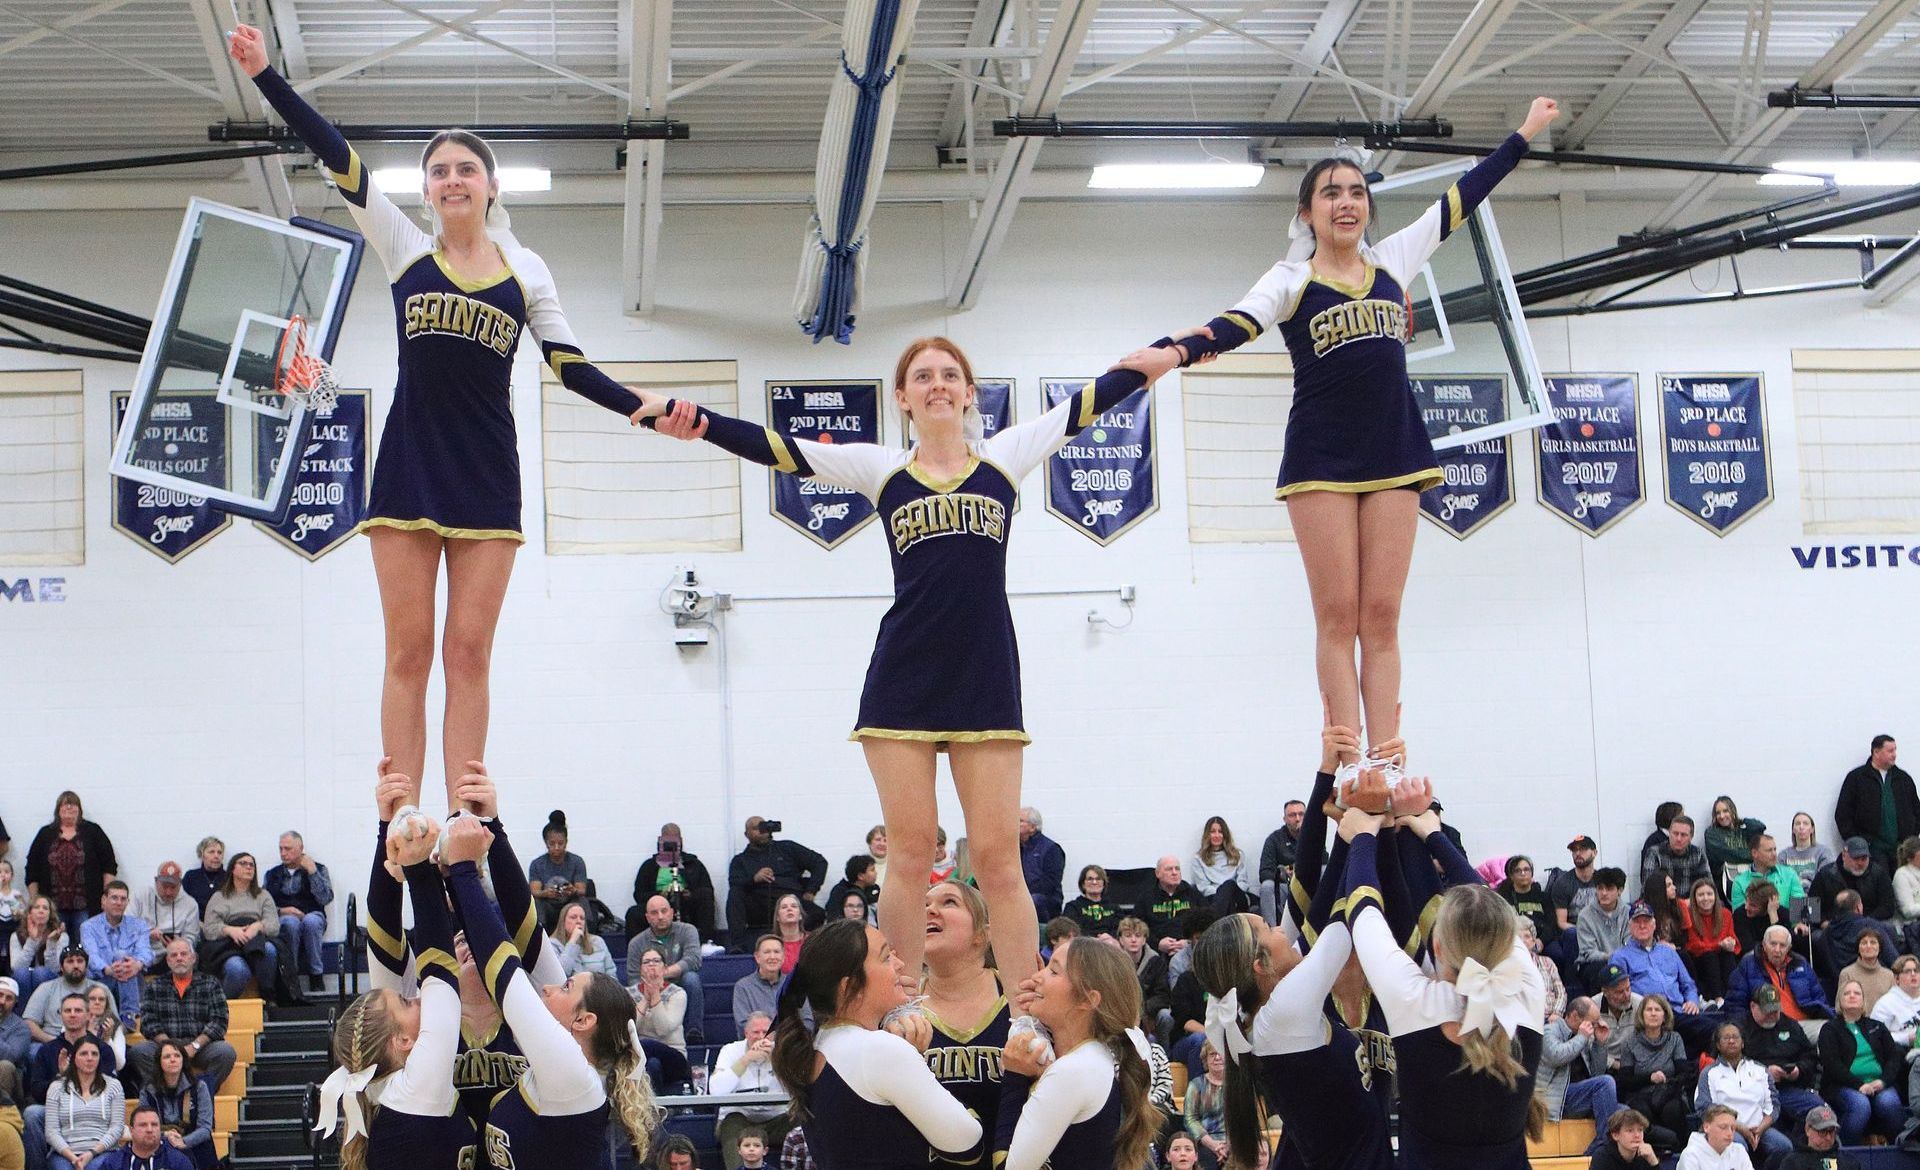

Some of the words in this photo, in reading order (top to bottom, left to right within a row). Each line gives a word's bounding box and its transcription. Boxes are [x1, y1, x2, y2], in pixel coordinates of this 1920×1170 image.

[405, 292, 519, 358] SAINTS
[1309, 299, 1406, 358] SAINTS
[773, 387, 795, 399] 2A
[1664, 379, 1684, 392] 2A
[1092, 413, 1134, 429] LACE
[1447, 408, 1489, 425] PLACE
[1578, 406, 1620, 423] PLACE
[1680, 407, 1704, 425] 3RD
[1706, 406, 1747, 424] PLACE
[790, 416, 815, 432] 2ND
[817, 415, 861, 431] PLACE
[143, 427, 161, 440] ND
[164, 426, 209, 443] PLACE
[312, 425, 349, 442] LACE
[1059, 446, 1095, 459] GIRLS
[1096, 444, 1142, 459] TENNIS
[1465, 440, 1504, 454] EYBALL
[1542, 439, 1572, 453] GIRLS
[1573, 437, 1636, 452] BASKETBALL
[1671, 438, 1696, 453] BOYS
[1698, 437, 1760, 452] BASKETBALL
[175, 458, 209, 473] GOLF
[310, 457, 354, 472] TRACK
[1562, 462, 1618, 484] 2017
[1688, 461, 1746, 484] 2018
[1071, 469, 1132, 491] 2016
[1439, 464, 1487, 486] 016
[891, 493, 1005, 555] SAINTS
[923, 1045, 1004, 1083] AINT
